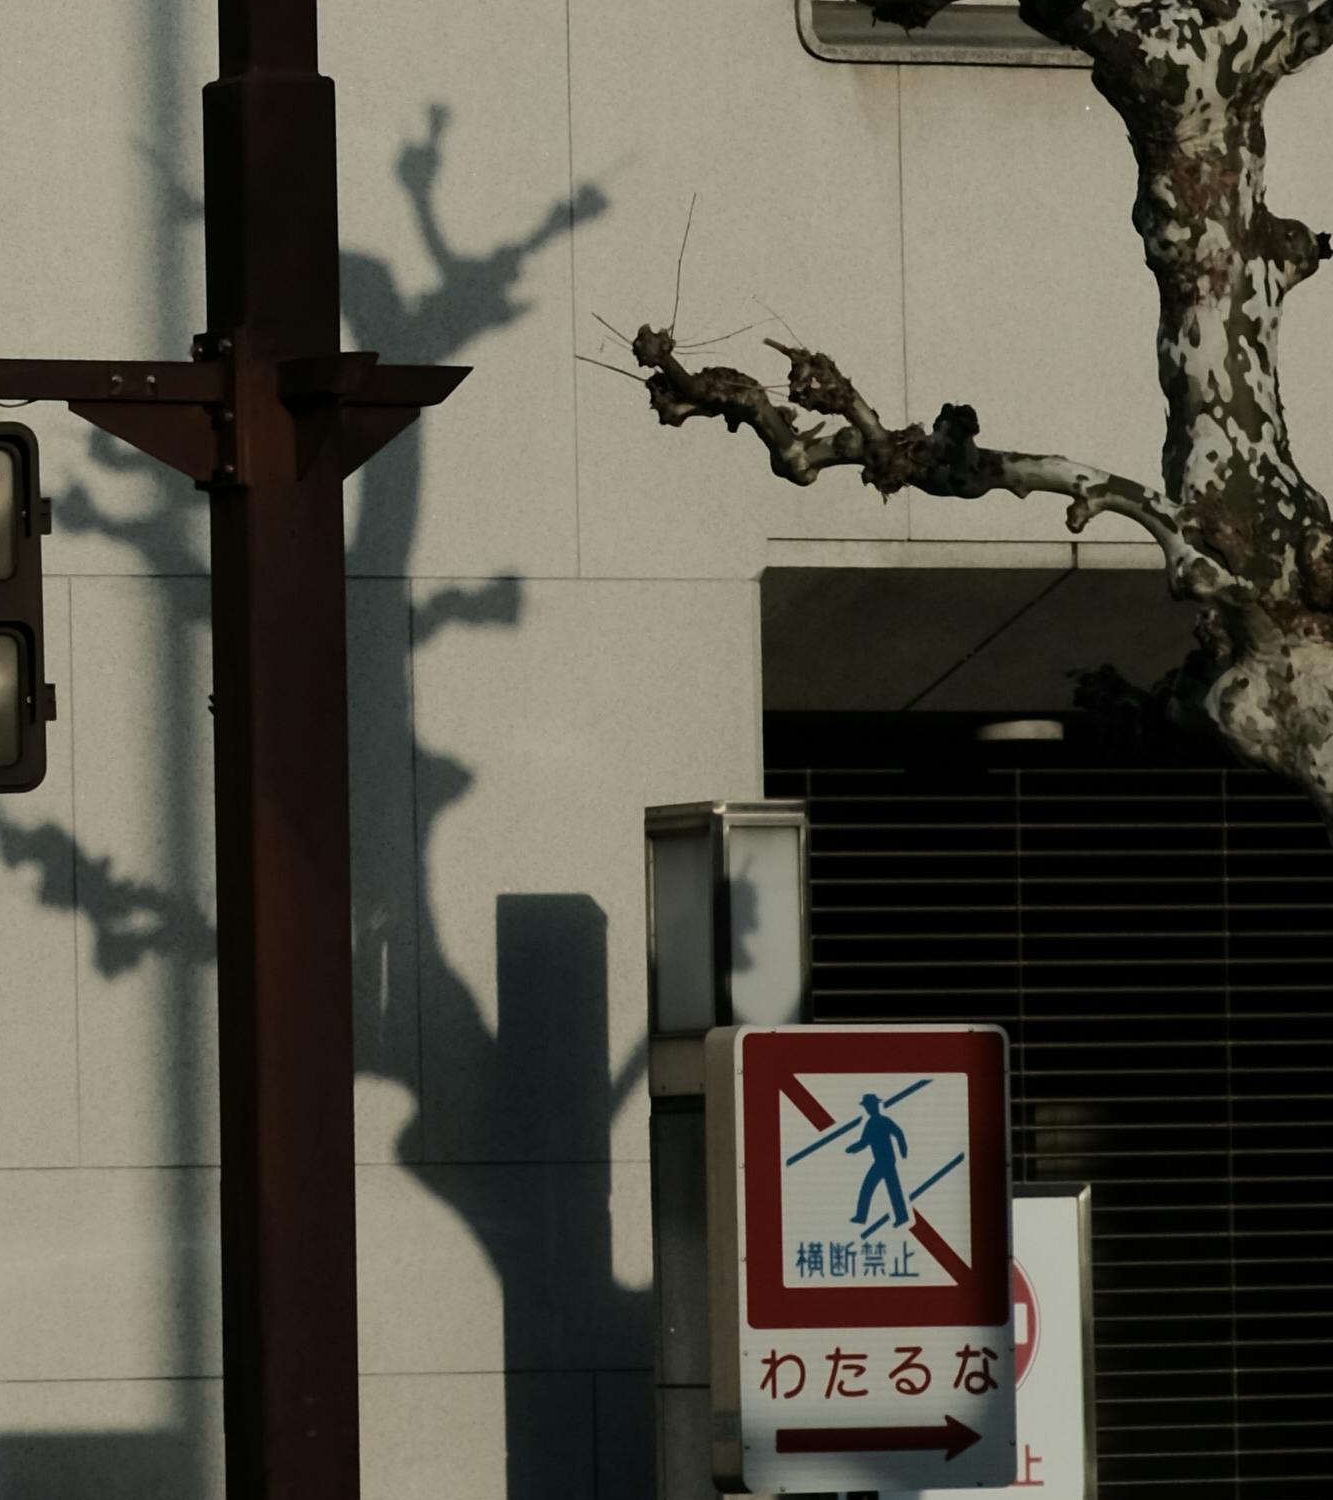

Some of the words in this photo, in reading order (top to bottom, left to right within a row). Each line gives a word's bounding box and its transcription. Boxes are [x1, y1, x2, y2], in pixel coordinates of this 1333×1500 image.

[796, 1241, 920, 1279] 横断禁止
[760, 1344, 999, 1400] わたるな
